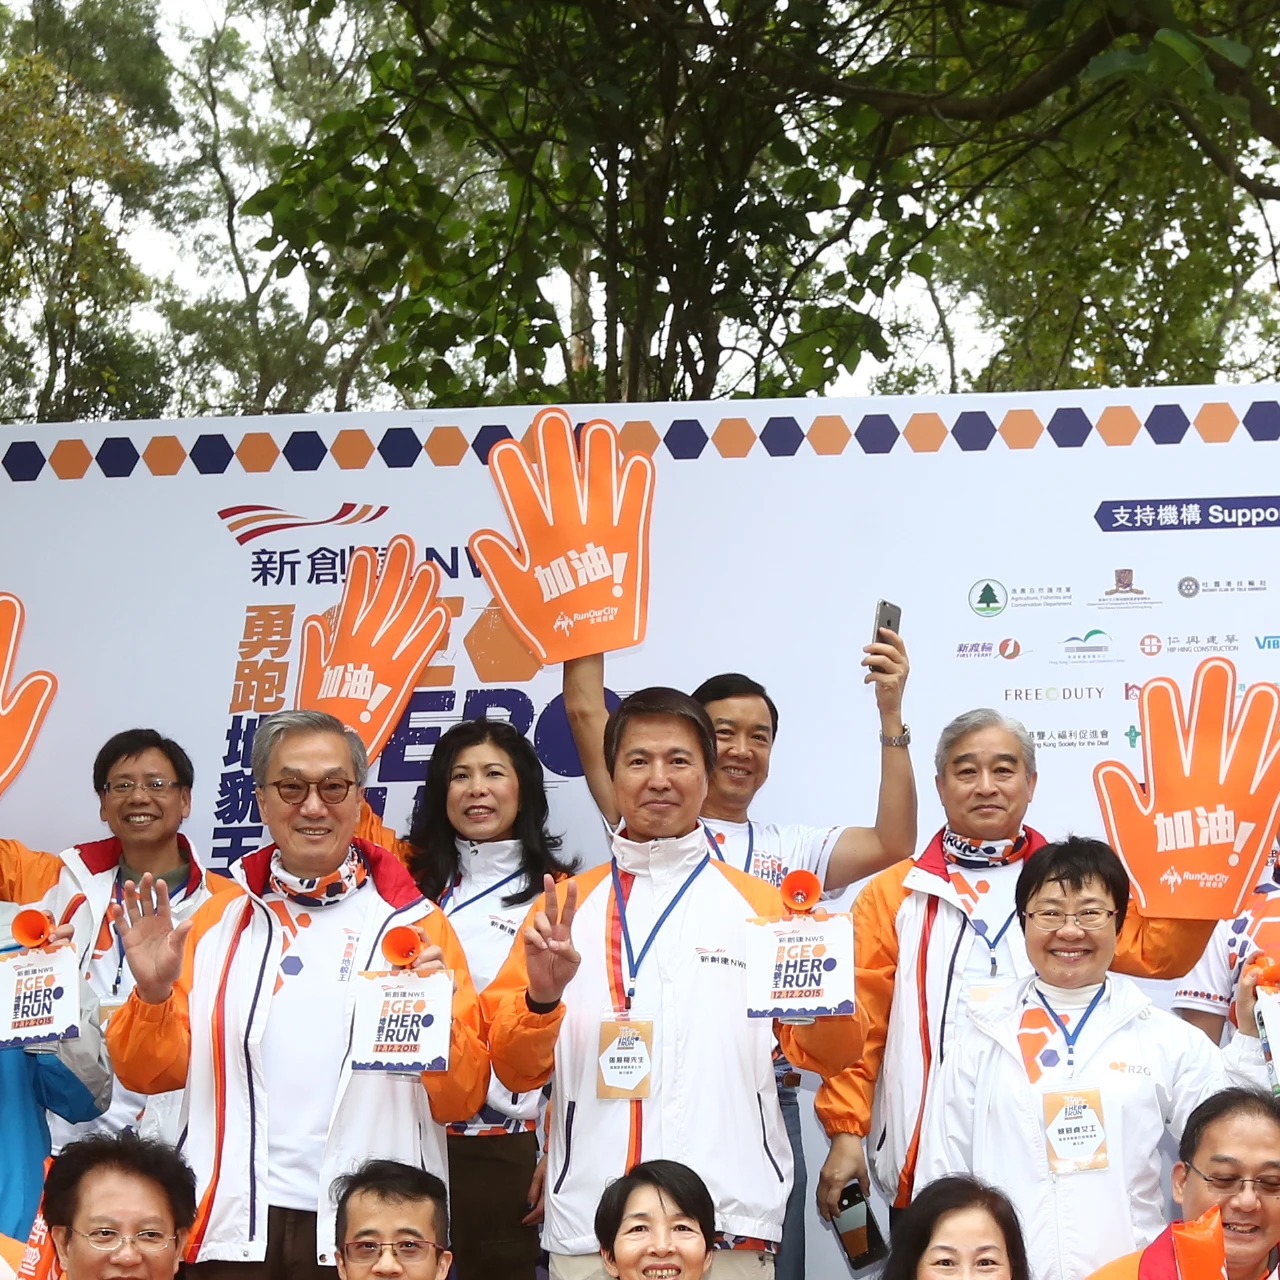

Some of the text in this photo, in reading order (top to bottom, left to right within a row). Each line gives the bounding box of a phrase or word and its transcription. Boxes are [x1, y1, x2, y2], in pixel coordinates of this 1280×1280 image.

[1112, 503, 1202, 527] 支持機構
[534, 542, 628, 603] 加油!
[573, 605, 619, 621] RunOurCity
[317, 663, 392, 724] 加油!
[1004, 686, 1104, 701] FREE DUTY
[1153, 803, 1257, 868] 加油!
[1183, 870, 1230, 884] RunOurCity
[38, 966, 54, 974] NWS
[782, 973, 823, 989] RUN
[773, 989, 821, 999] 12.12.2015
[20, 1001, 53, 1019] RUN
[13, 1016, 52, 1030] 12.12.2015
[384, 1028, 421, 1042] RUN
[374, 1044, 418, 1053] 12.12.2015
[1127, 1065, 1152, 1076] R2G
